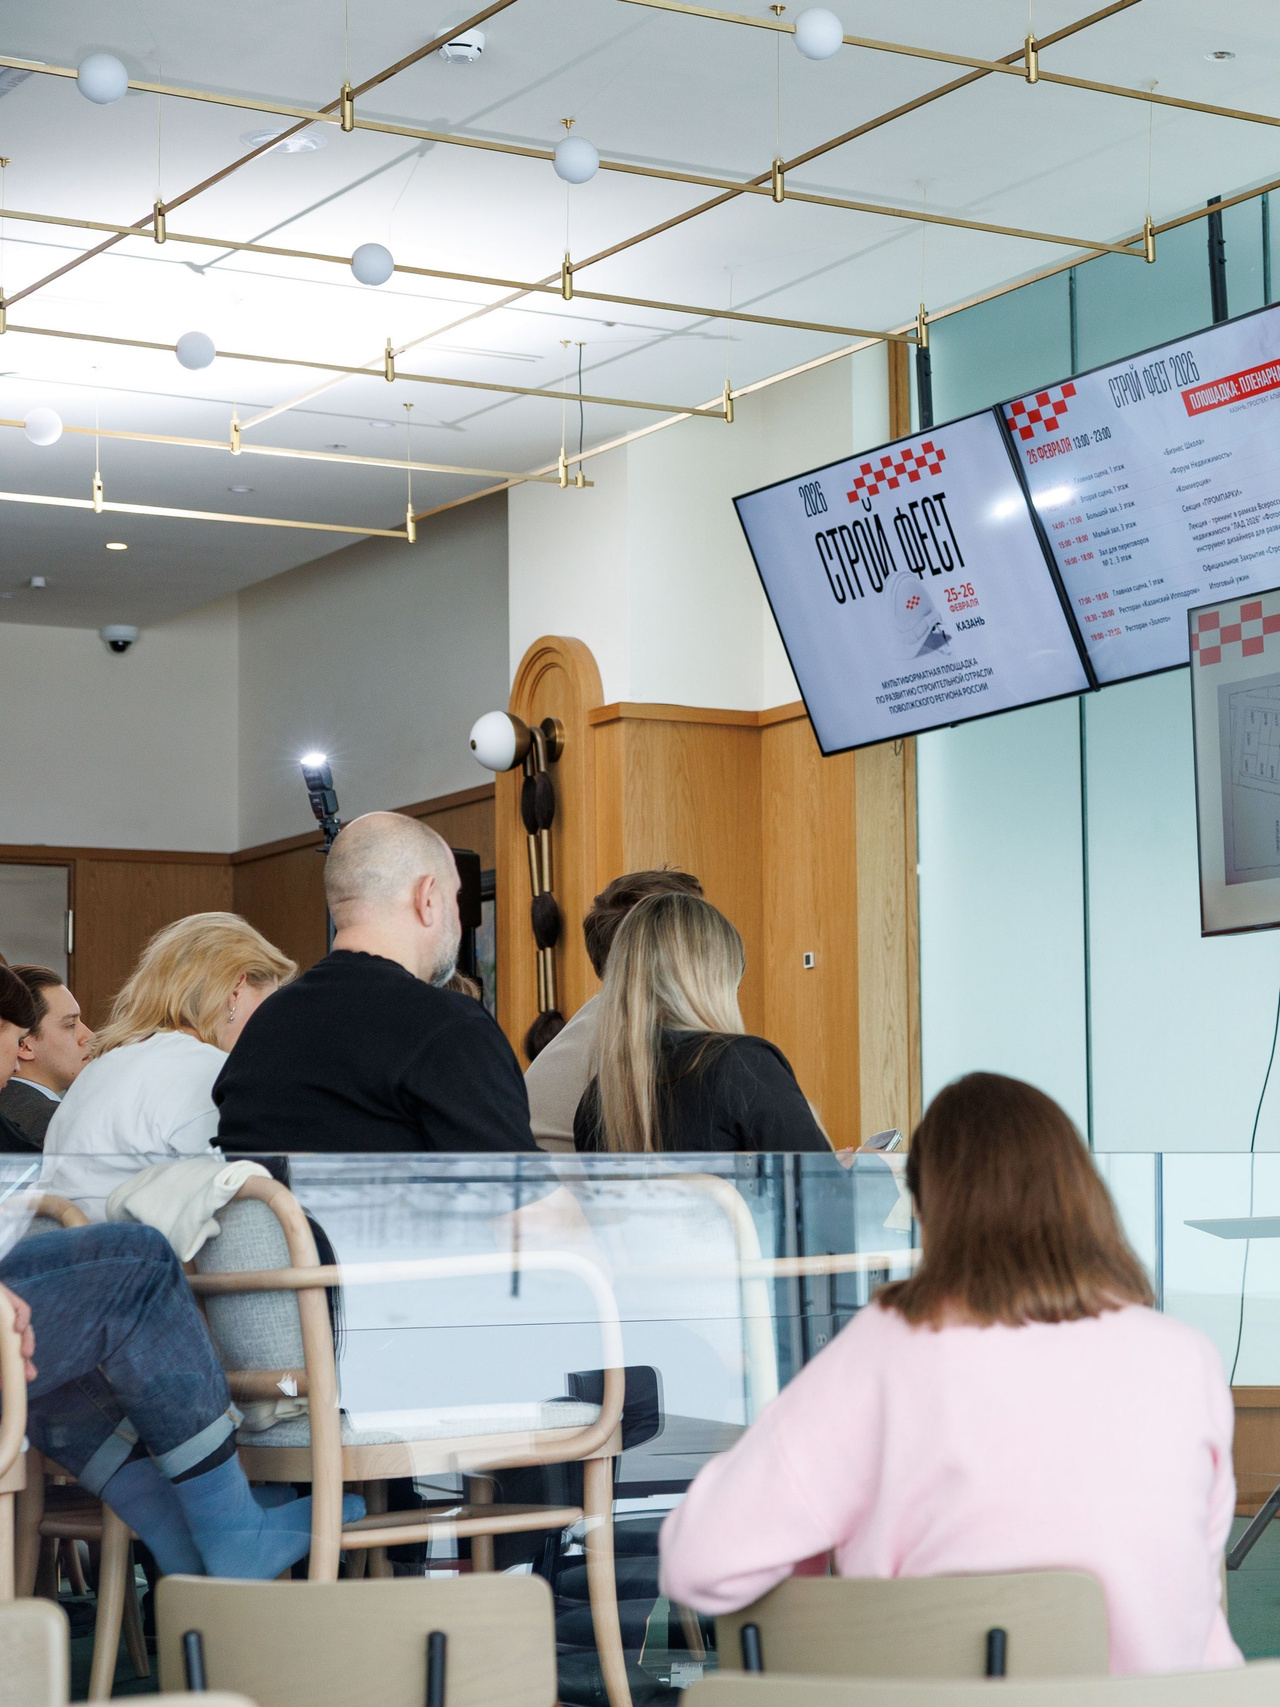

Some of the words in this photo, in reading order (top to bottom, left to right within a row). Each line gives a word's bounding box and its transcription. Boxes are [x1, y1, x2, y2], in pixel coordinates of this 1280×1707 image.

[1108, 363, 1146, 408] СТРОЙ
[1142, 359, 1172, 396] ФЕСТ
[1168, 350, 1200, 388] 2026
[1188, 380, 1241, 410] ПЛОЩАДКА:
[1025, 448, 1038, 465] 26
[1036, 436, 1073, 460] ФЕВРАЛЯ
[1072, 433, 1090, 449] 13:00
[1092, 426, 1112, 443] 23:00
[1163, 445, 1184, 456] «Бизнес
[1183, 439, 1205, 450] Школа»
[1169, 464, 1190, 474] «Форум
[1189, 451, 1232, 468] Недвижимость»
[1175, 478, 1212, 492] «Коммерция»
[798, 480, 828, 518] 2026
[1181, 502, 1201, 513] Секция
[1202, 489, 1242, 505] «ПРОМПАРКИ»
[815, 496, 898, 604] СТРОЙ
[893, 491, 965, 580] ФЕСТ
[1202, 557, 1239, 572] Официальное
[1239, 550, 1265, 562] Закрытие
[943, 582, 975, 603] 25-26
[1208, 576, 1235, 590] Итоговый
[1235, 575, 1250, 585] ужин
[949, 597, 979, 613] ФЕВРАЛЯ
[1118, 603, 1141, 613] Ресторан
[1141, 593, 1170, 607] «Казанский
[1169, 588, 1200, 600] Ипподром»
[955, 616, 985, 631] КАЗАНЬ
[1125, 622, 1148, 632] Ресторан
[1148, 616, 1171, 626] «Золото»
[875, 695, 885, 704] ПО
[884, 687, 917, 702] РАЗВИТИЮ
[916, 675, 964, 694] СТРОИТЕЛЬНОЙ
[964, 667, 993, 681] ОТРАСЛИ
[881, 667, 941, 689] МУЛЬТИФОРМАТНАЯ
[940, 658, 978, 673] ПЛОЩАДКА
[888, 696, 935, 714] ПОВОЛЖСКОГО
[934, 689, 963, 702] РЕГИОНА
[962, 682, 988, 695] РОССИИ
